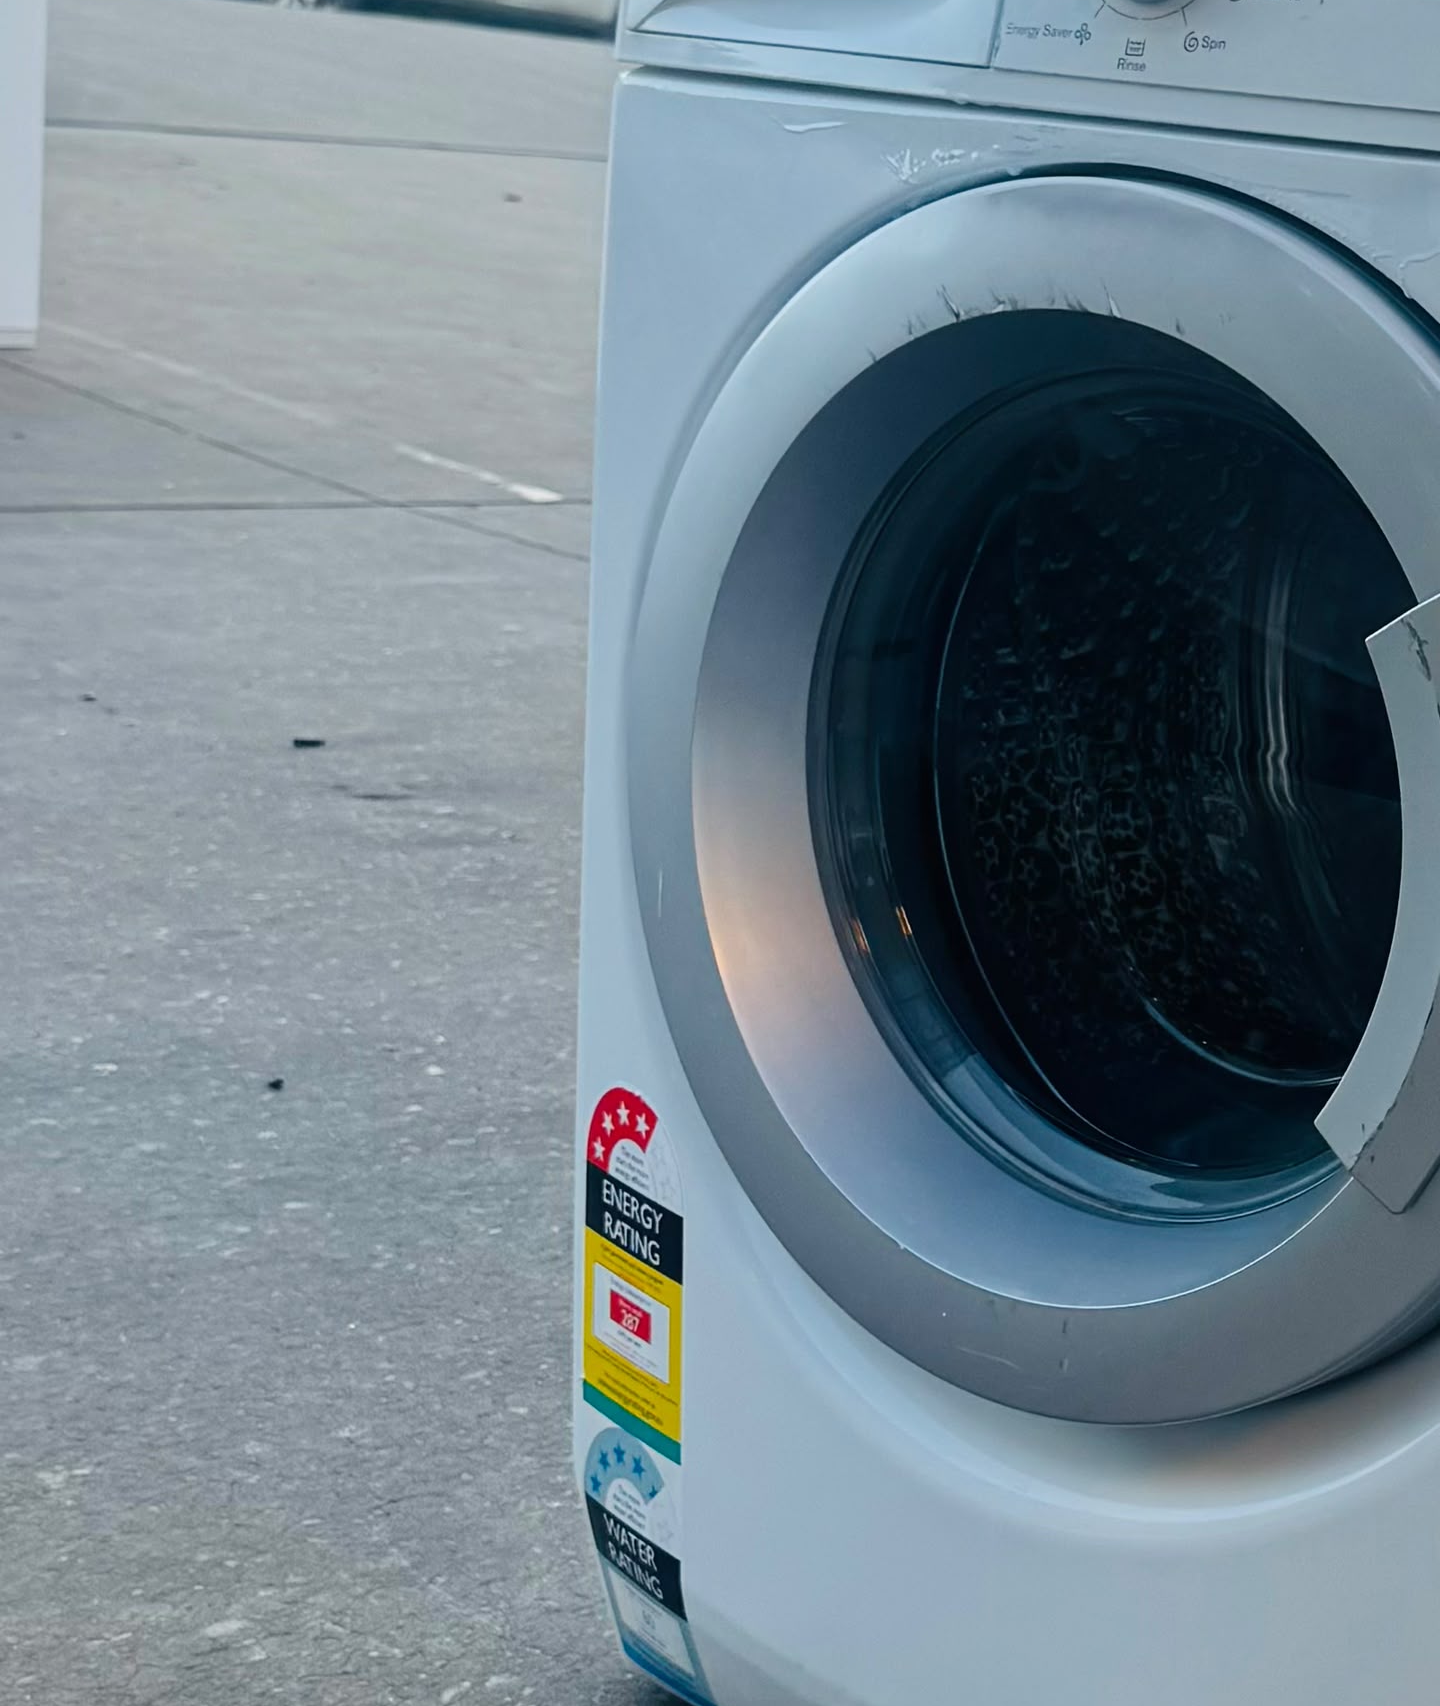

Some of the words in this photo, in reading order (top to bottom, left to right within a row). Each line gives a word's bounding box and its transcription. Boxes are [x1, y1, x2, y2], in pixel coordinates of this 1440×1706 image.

[1006, 22, 1040, 39] Energy
[1043, 24, 1072, 38] Saver
[1201, 35, 1226, 51] Spin
[1116, 57, 1146, 72] Rinse
[602, 1179, 663, 1235] ENERGY
[604, 1210, 661, 1267] RATING
[603, 1512, 657, 1572] WATER
[608, 1540, 664, 1600] RATING
